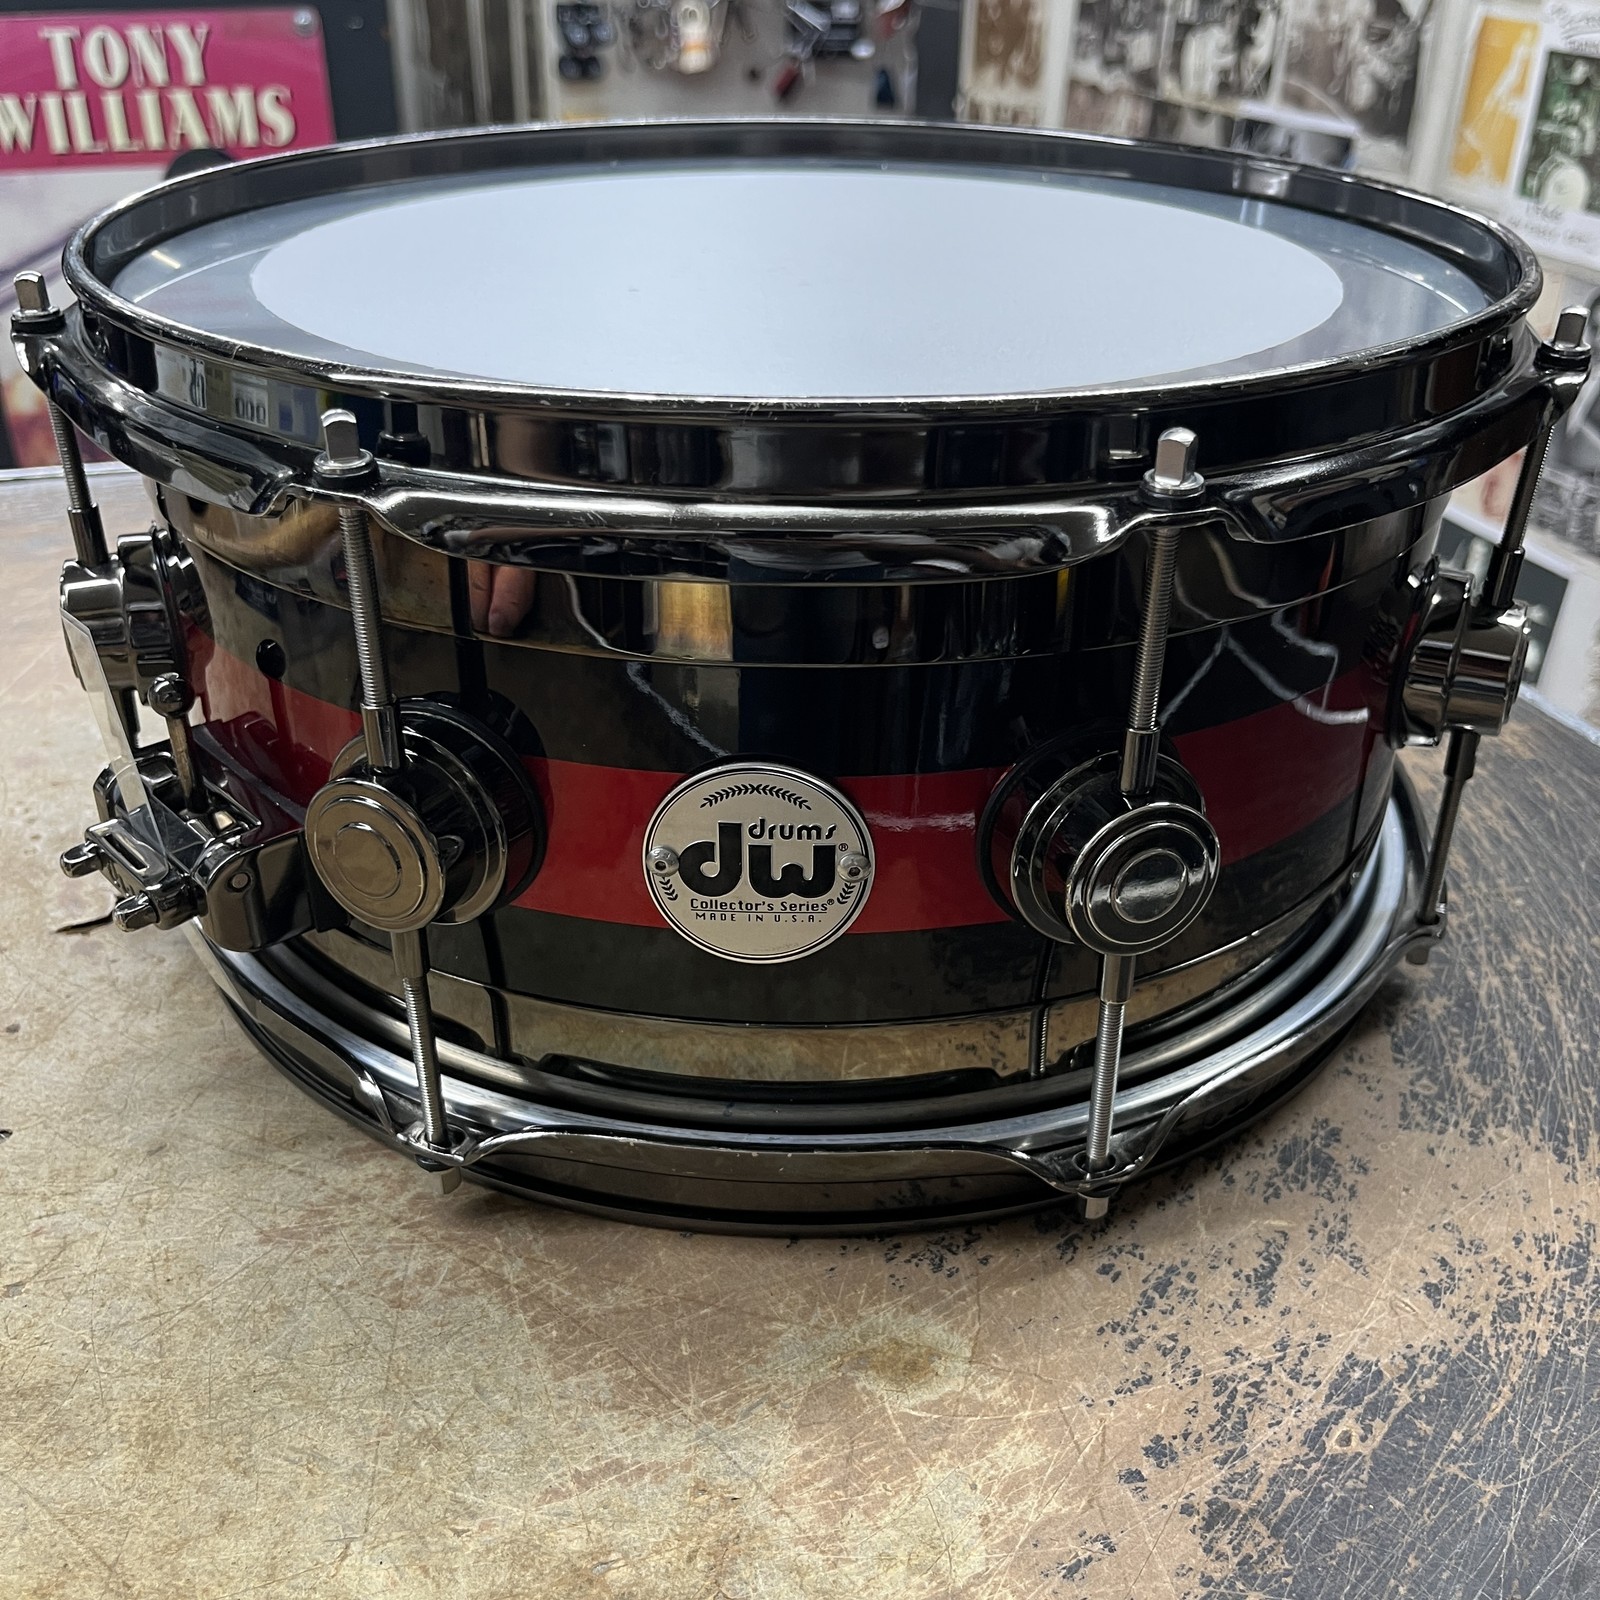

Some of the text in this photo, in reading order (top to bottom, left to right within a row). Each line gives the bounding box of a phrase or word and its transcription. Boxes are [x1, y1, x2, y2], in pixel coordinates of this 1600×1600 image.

[37, 22, 210, 90] TONY
[0, 84, 296, 154] WILLIAMS
[747, 817, 837, 840] drums
[690, 898, 775, 912] Collector's
[695, 912, 822, 923] MADE IN U.S.A.
